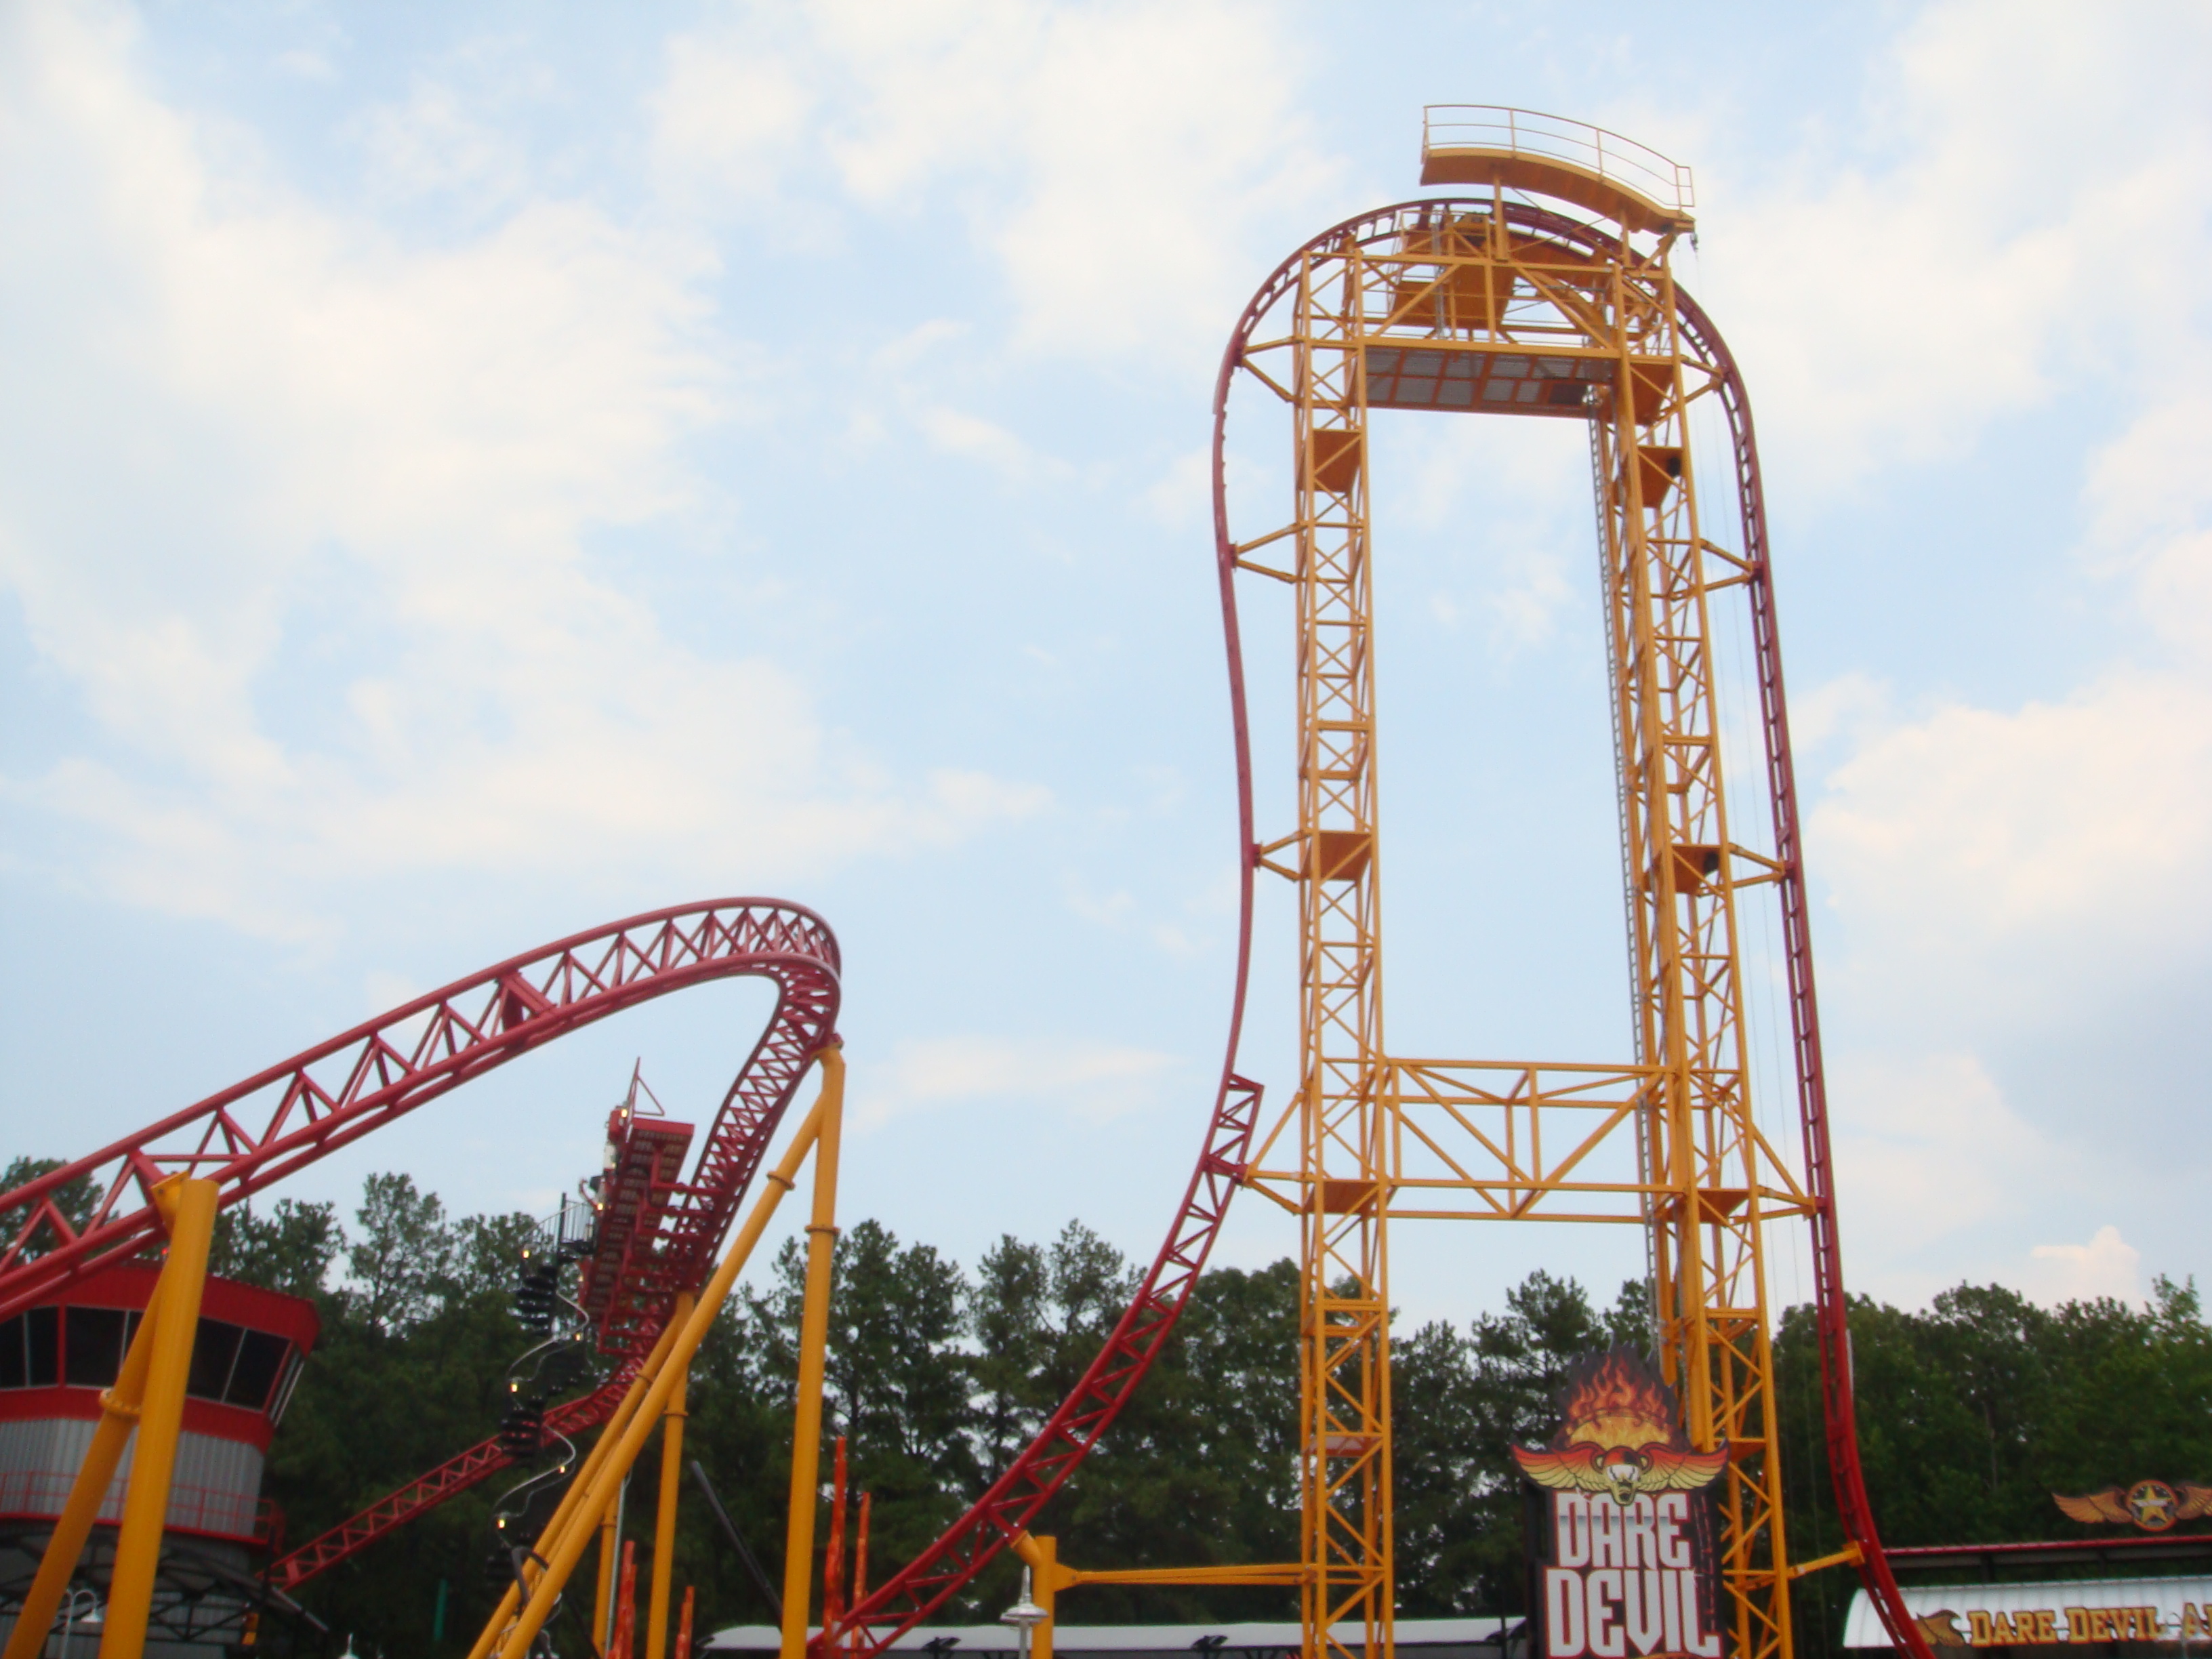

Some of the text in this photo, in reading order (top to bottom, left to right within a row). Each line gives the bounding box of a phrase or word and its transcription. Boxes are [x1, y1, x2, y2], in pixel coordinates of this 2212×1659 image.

[1555, 1492, 1692, 1571] DARE
[1545, 1568, 1723, 1658] DEVIL
[1967, 1610, 2058, 1647] DARE
[2064, 1606, 2167, 1644] DEVIL
